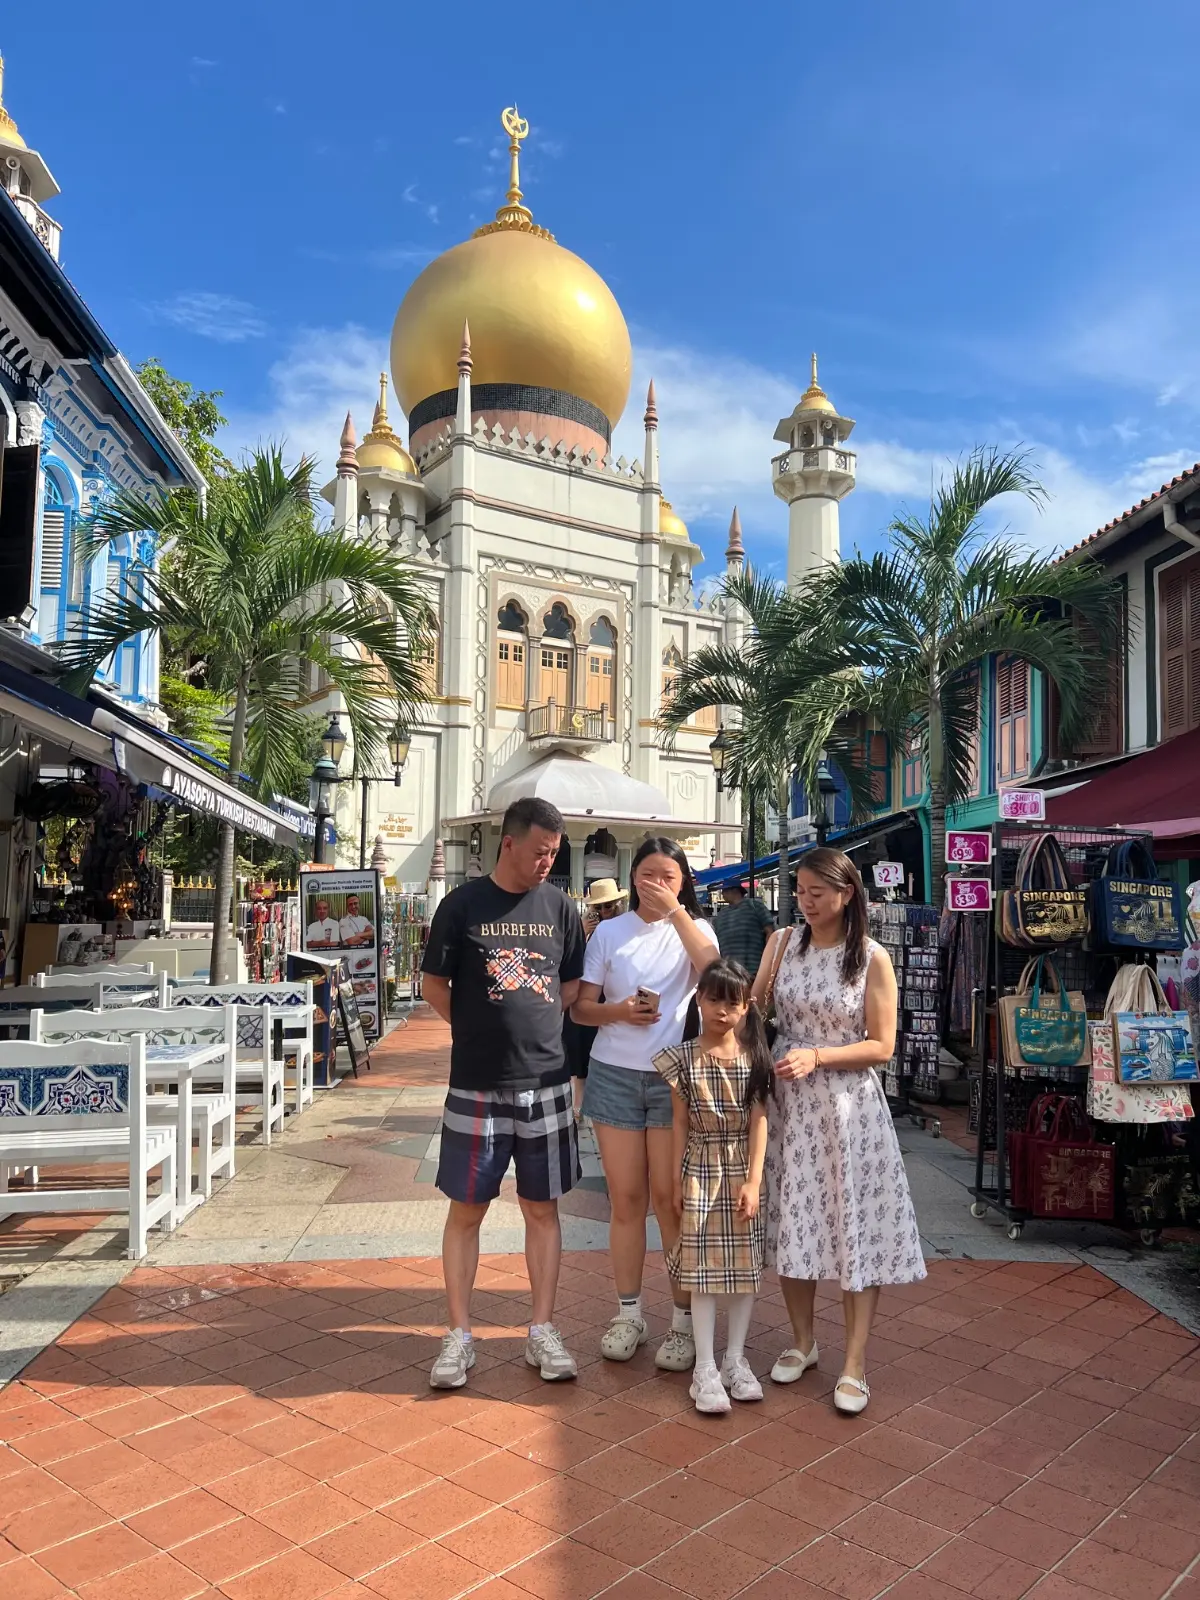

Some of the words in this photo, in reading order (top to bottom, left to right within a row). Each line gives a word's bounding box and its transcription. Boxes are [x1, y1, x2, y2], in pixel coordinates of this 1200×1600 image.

[172, 773, 215, 812] AYASOFYA
[216, 795, 244, 825] TURKISH
[243, 808, 277, 840] RESTAURANT
[878, 868, 892, 883] $2
[1022, 891, 1086, 902] SINGAPORE
[1109, 881, 1173, 898] SINGAPORE
[481, 923, 554, 937] BURBERRY
